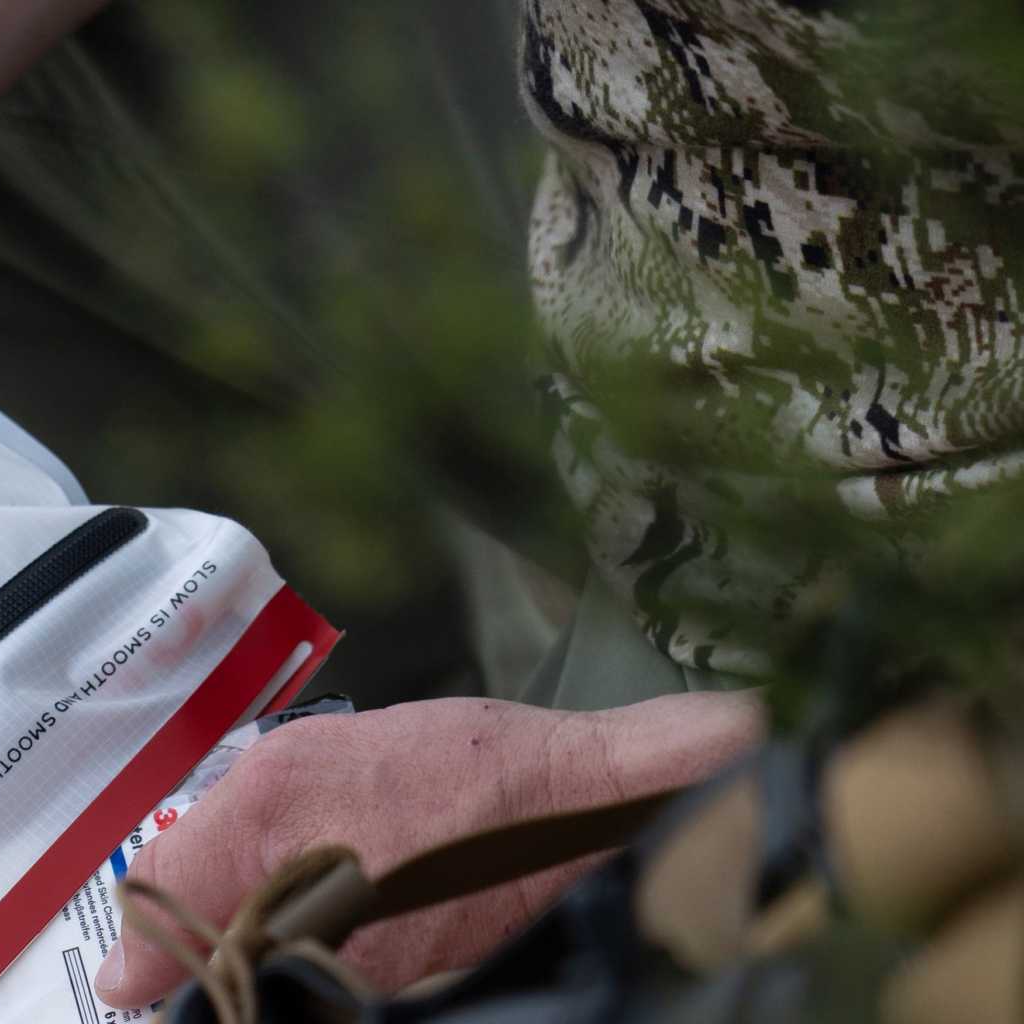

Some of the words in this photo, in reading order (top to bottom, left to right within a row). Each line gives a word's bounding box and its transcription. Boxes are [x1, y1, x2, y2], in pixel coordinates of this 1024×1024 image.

[170, 560, 217, 611] SLOW
[150, 609, 170, 628] IS
[80, 629, 152, 698] SMOOTH
[54, 692, 83, 713] AND
[98, 887, 108, 905] Skin
[103, 905, 118, 941] Closures
[104, 1011, 117, 1020] 6
